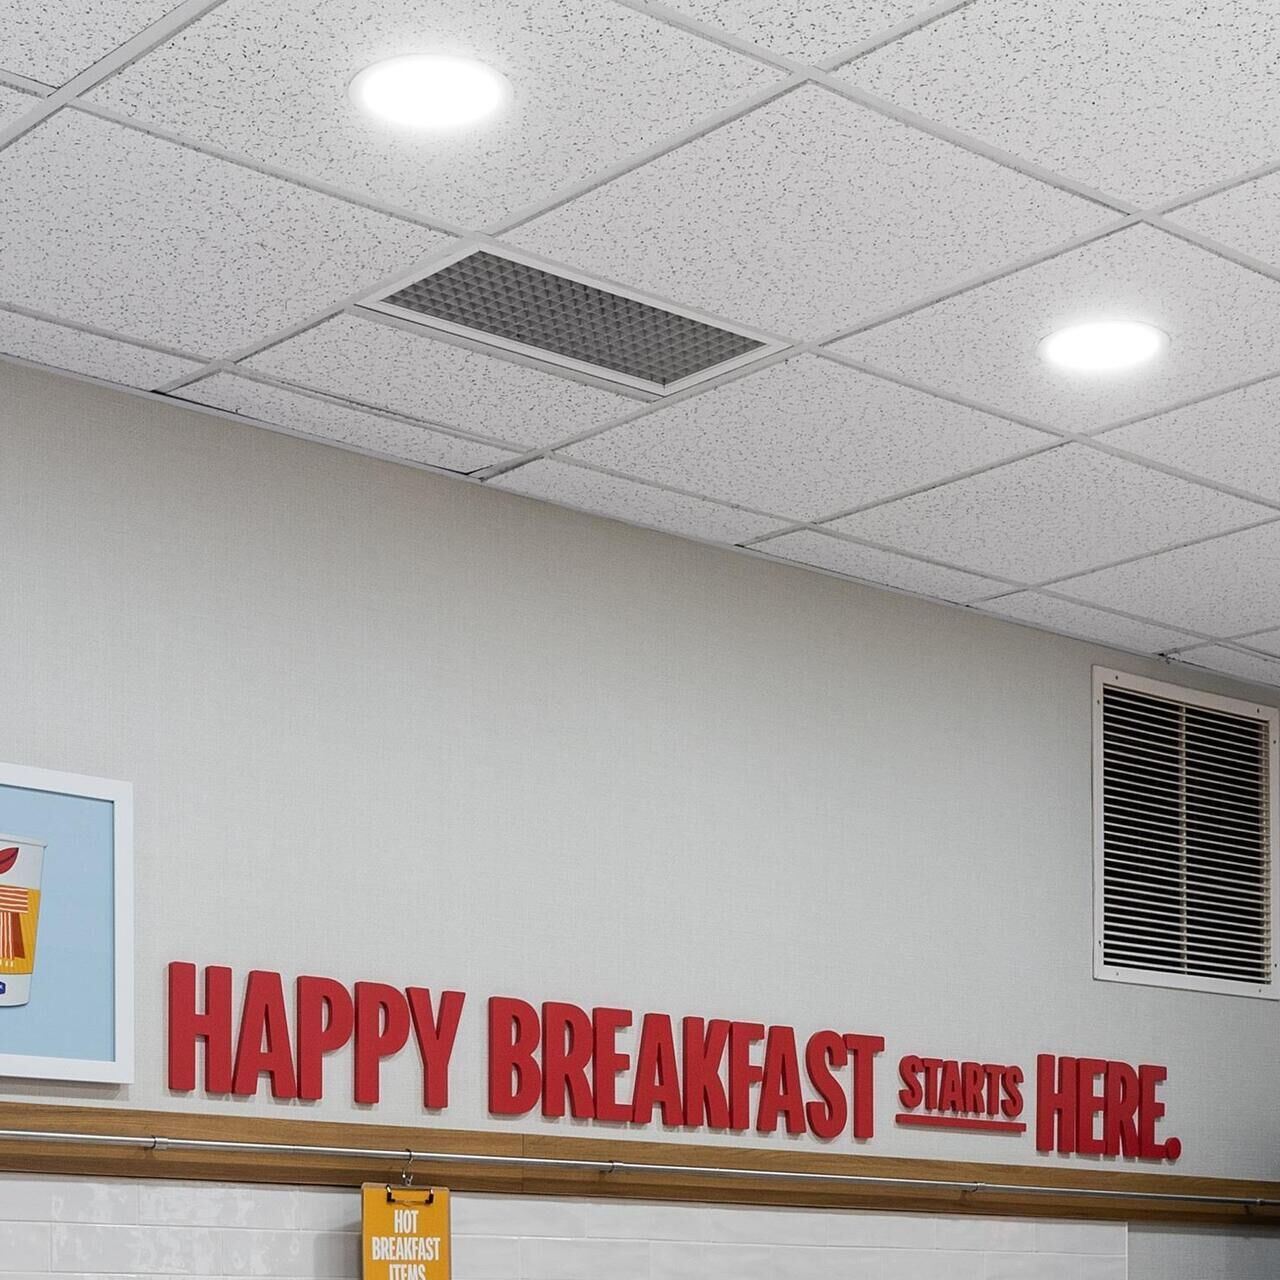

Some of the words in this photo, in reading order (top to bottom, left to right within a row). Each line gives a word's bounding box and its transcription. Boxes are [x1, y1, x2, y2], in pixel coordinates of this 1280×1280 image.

[168, 961, 466, 1109] HAPPY
[489, 996, 885, 1140] BREAKFAST
[898, 1055, 1024, 1126] STARTS
[1036, 1053, 1182, 1161] HERE.
[394, 1209, 419, 1234] HOT
[372, 1236, 441, 1262] BREAKFAST
